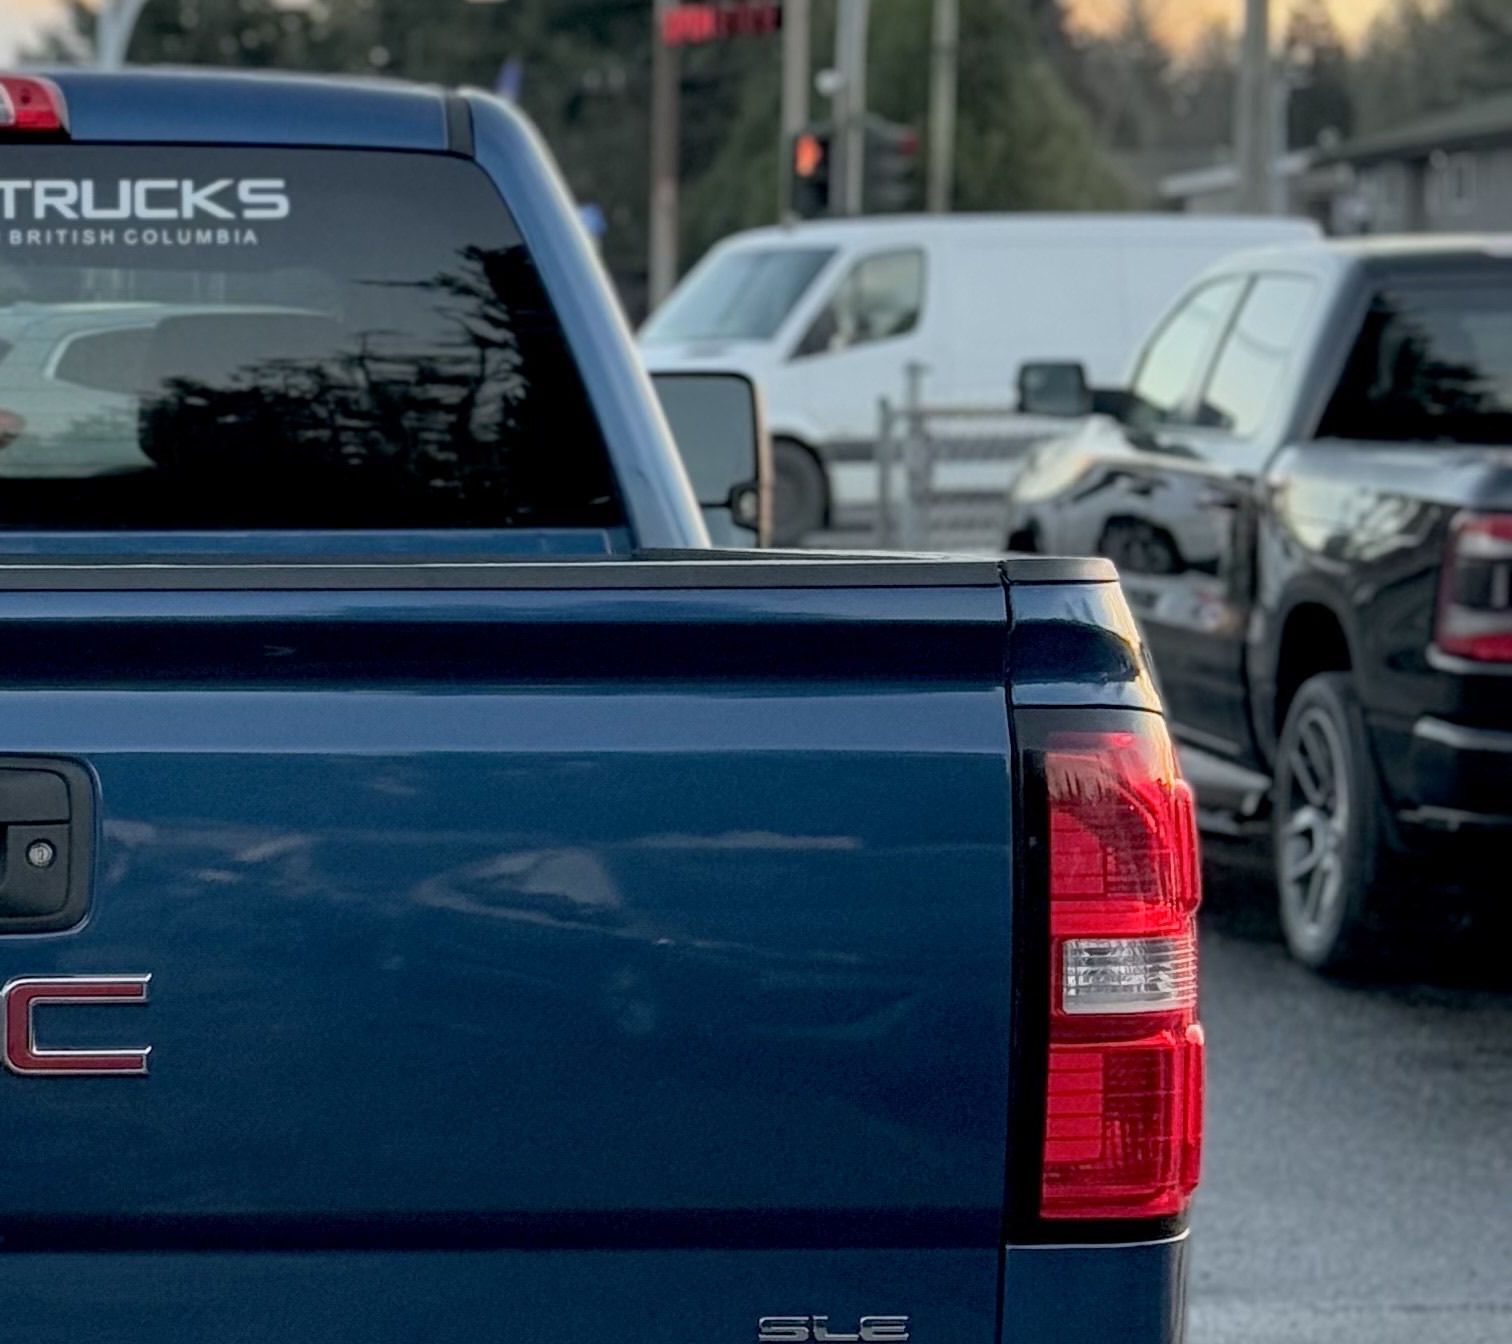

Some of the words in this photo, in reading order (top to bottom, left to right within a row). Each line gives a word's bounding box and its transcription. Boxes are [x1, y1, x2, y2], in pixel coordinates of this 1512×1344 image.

[9, 229, 115, 245] BRITISH
[123, 228, 259, 245] COLUMBIA
[758, 1315, 910, 1342] SLE
